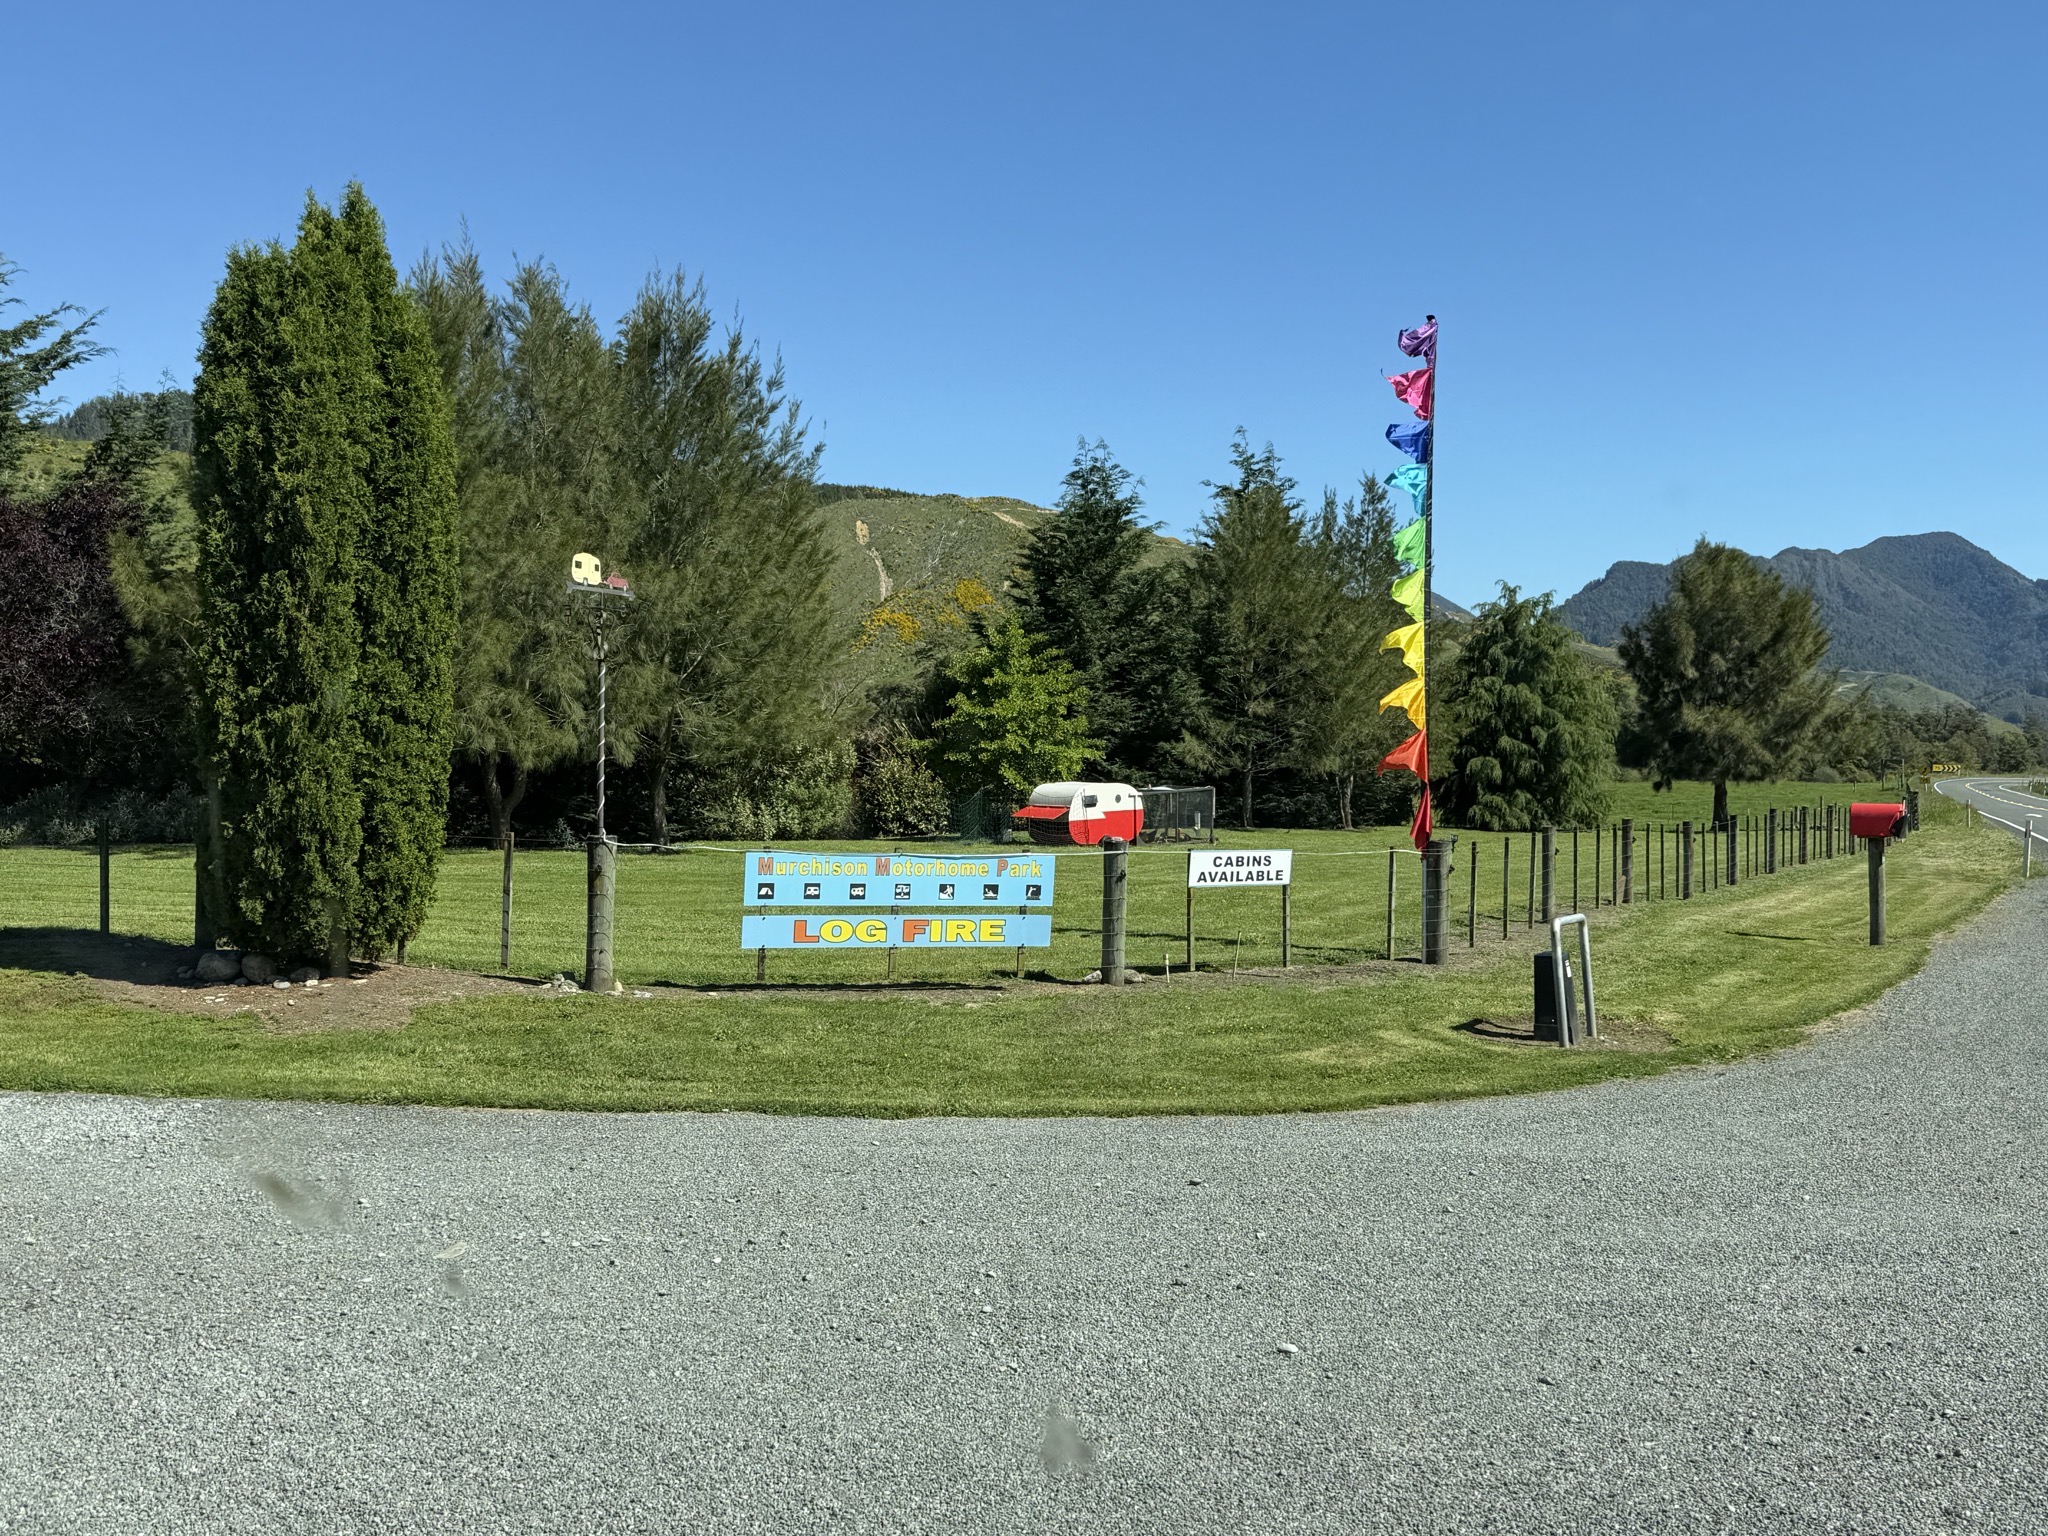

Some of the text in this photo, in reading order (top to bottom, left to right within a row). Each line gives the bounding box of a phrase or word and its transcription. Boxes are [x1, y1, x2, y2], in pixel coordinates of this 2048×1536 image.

[758, 856, 1042, 878] Murchison Motorhome Park
[1213, 855, 1272, 867] CABINS
[1197, 870, 1284, 883] AVAILABLE
[793, 919, 1006, 943] LOG FIRE
